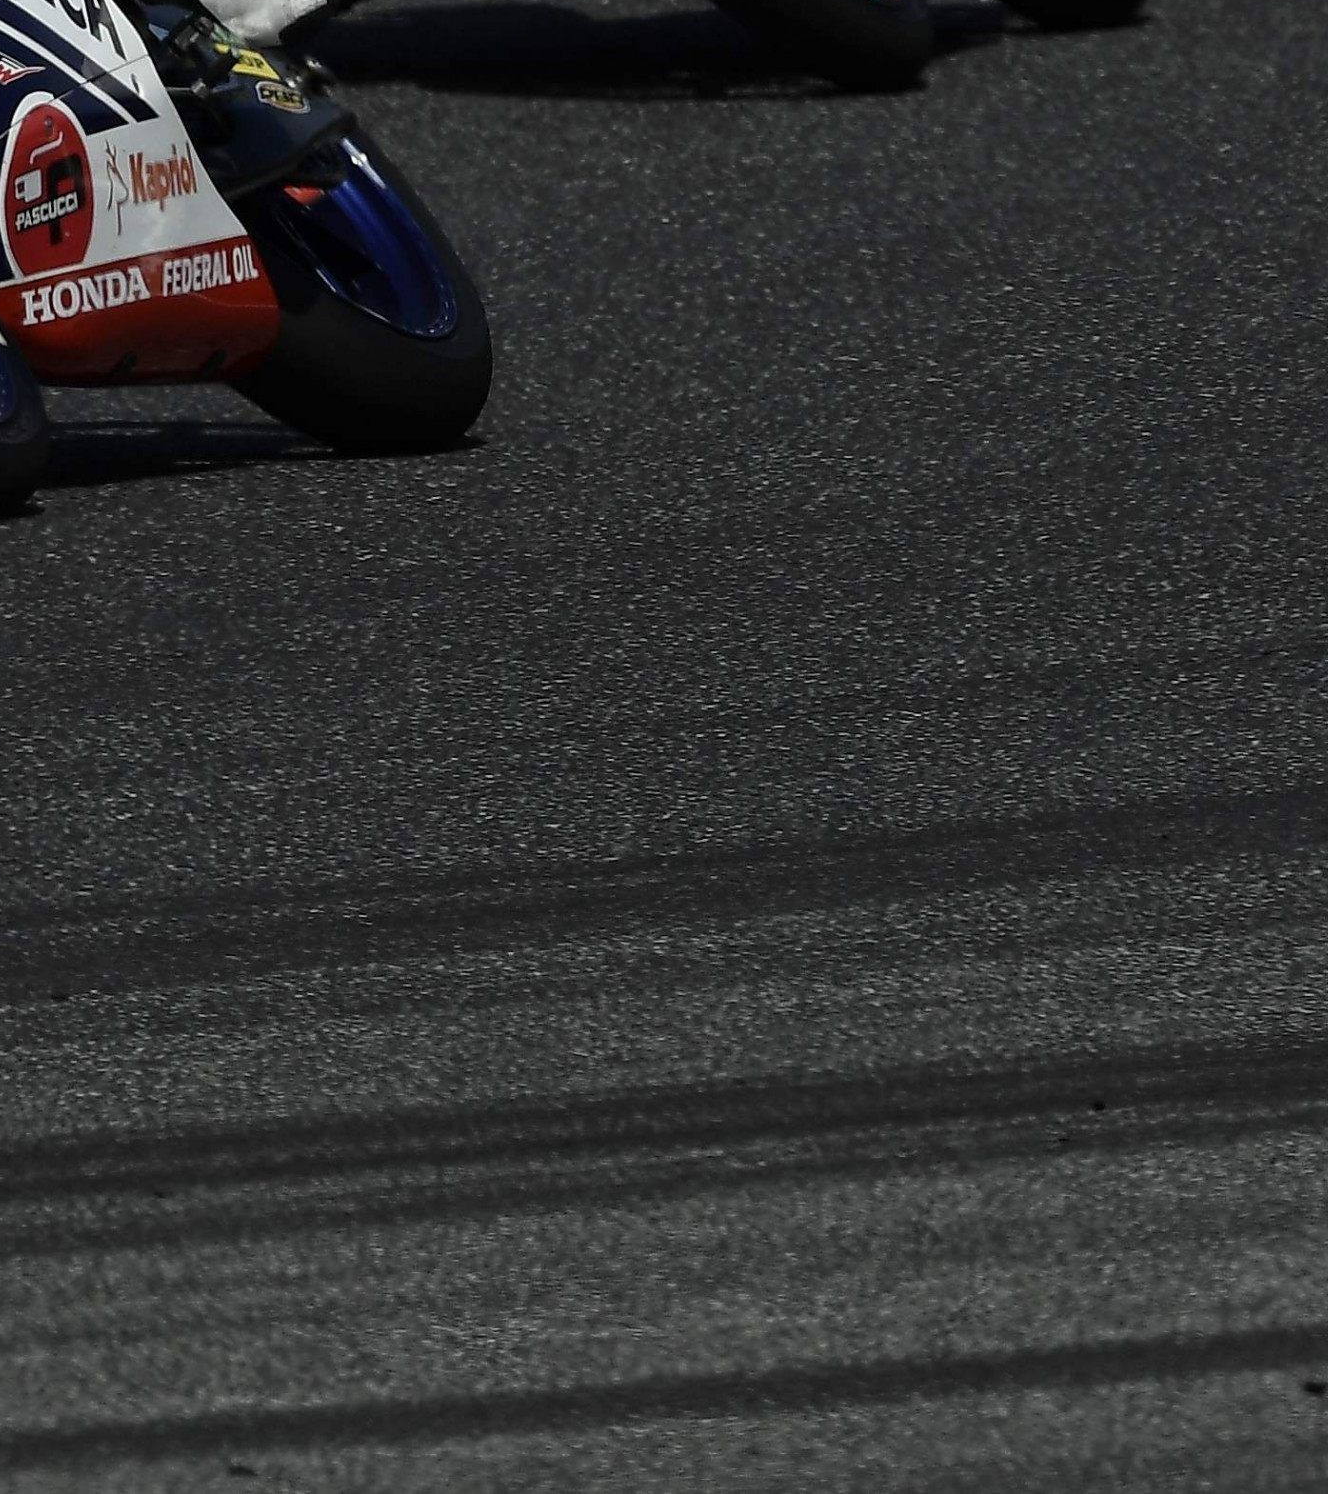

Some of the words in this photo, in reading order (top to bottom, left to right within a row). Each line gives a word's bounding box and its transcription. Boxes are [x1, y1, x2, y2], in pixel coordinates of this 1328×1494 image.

[15, 191, 79, 233] PASCUCCI
[128, 140, 198, 212] Kapriol
[21, 266, 152, 327] HONDA
[161, 249, 232, 298] FEDERAL
[231, 244, 259, 284] OIL
